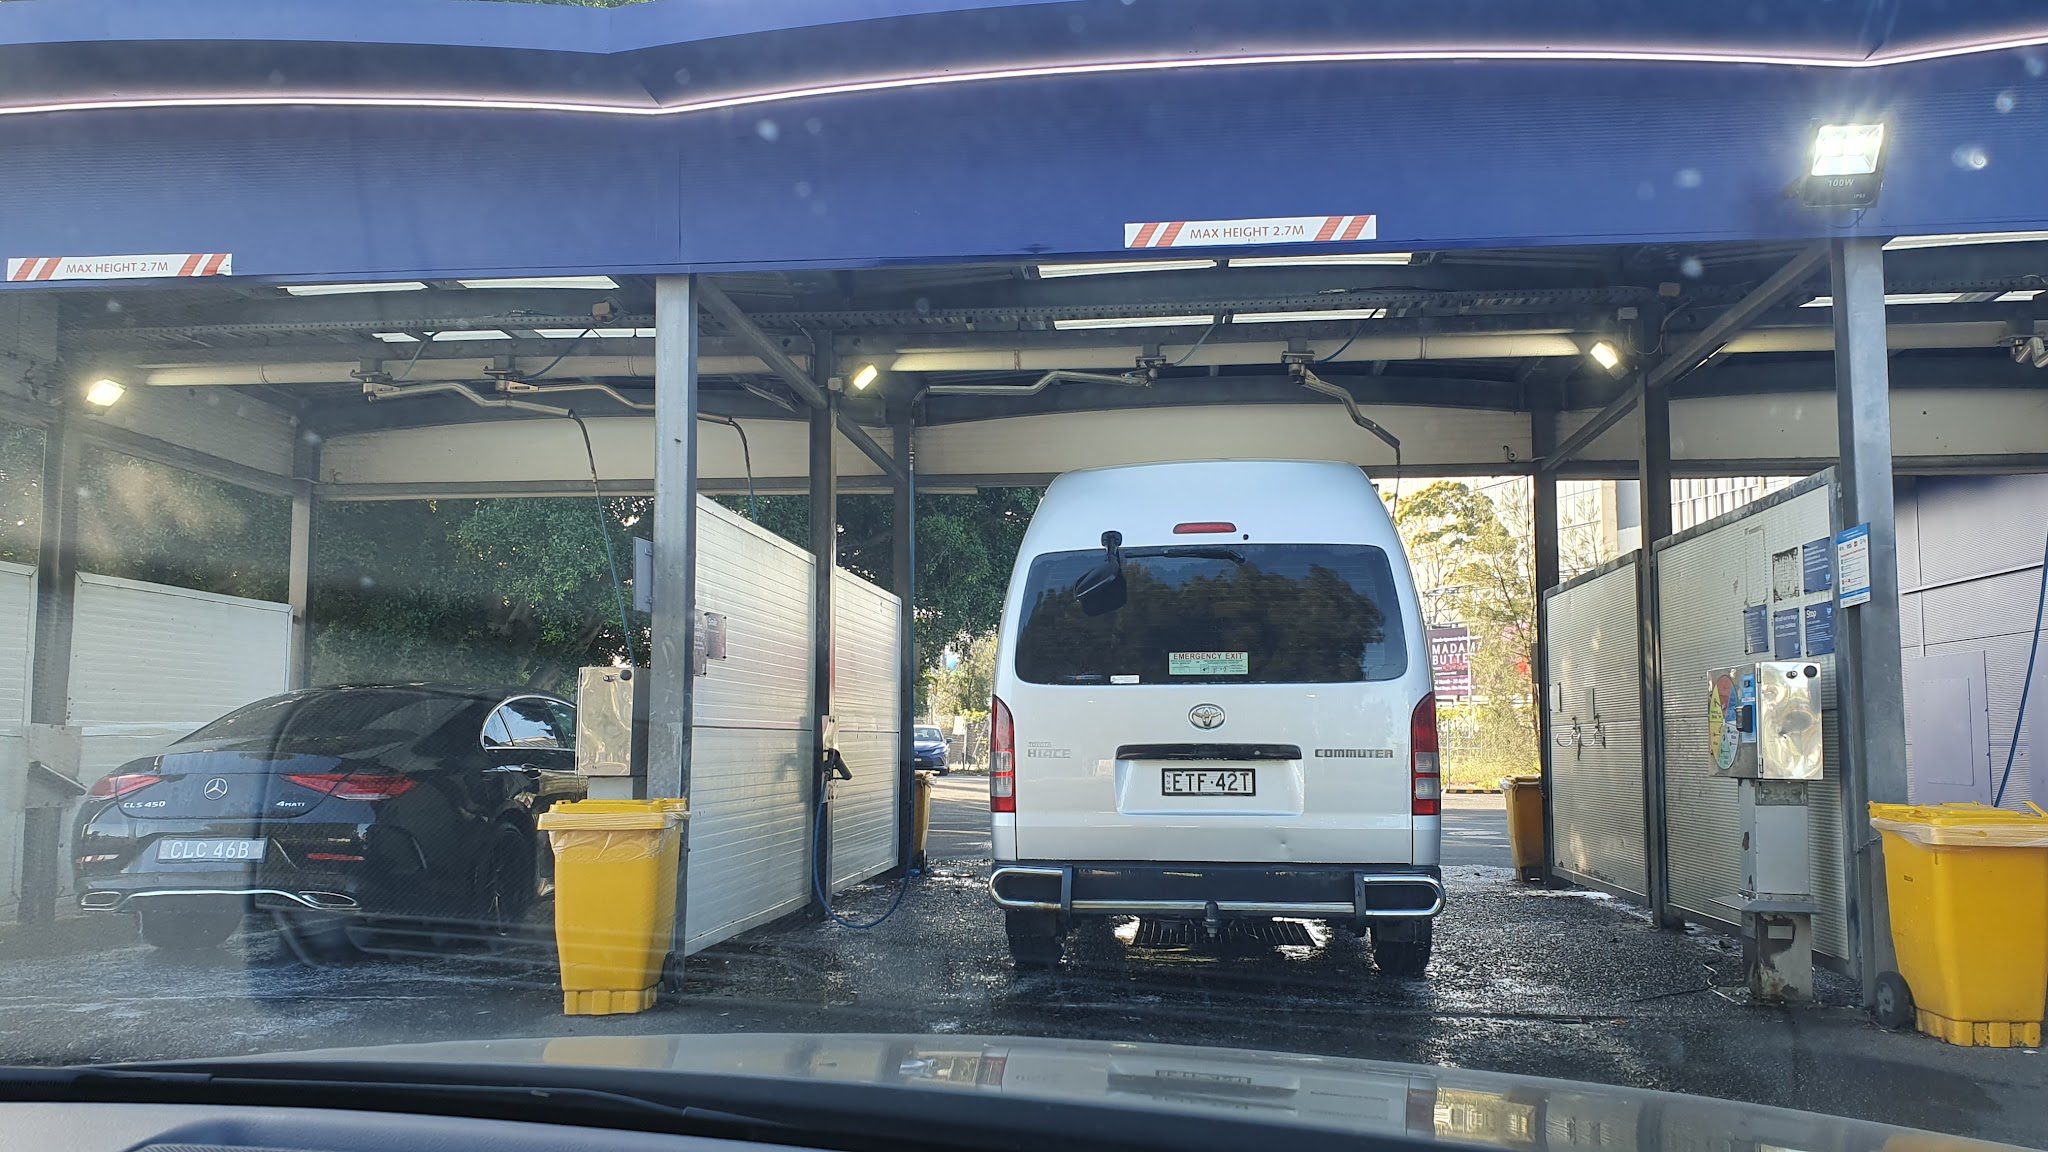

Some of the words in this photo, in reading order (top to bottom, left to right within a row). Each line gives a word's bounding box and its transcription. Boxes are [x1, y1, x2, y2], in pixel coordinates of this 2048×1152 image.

[1828, 178, 1854, 187] 100W
[1190, 228, 1218, 239] MAX
[1223, 226, 1269, 238] HEIGHT
[1273, 225, 1304, 237] 2.7M
[66, 264, 92, 273] MAX
[95, 262, 137, 273] HEIGHT
[140, 261, 168, 272] 2.7M
[1225, 652, 1243, 660] EXIT
[1027, 749, 1071, 759] HIACE
[1314, 748, 1394, 758] COMMUTER
[123, 801, 143, 809] CLS
[144, 800, 166, 808] 450
[170, 841, 207, 859] CLC
[212, 841, 250, 859] 46B
